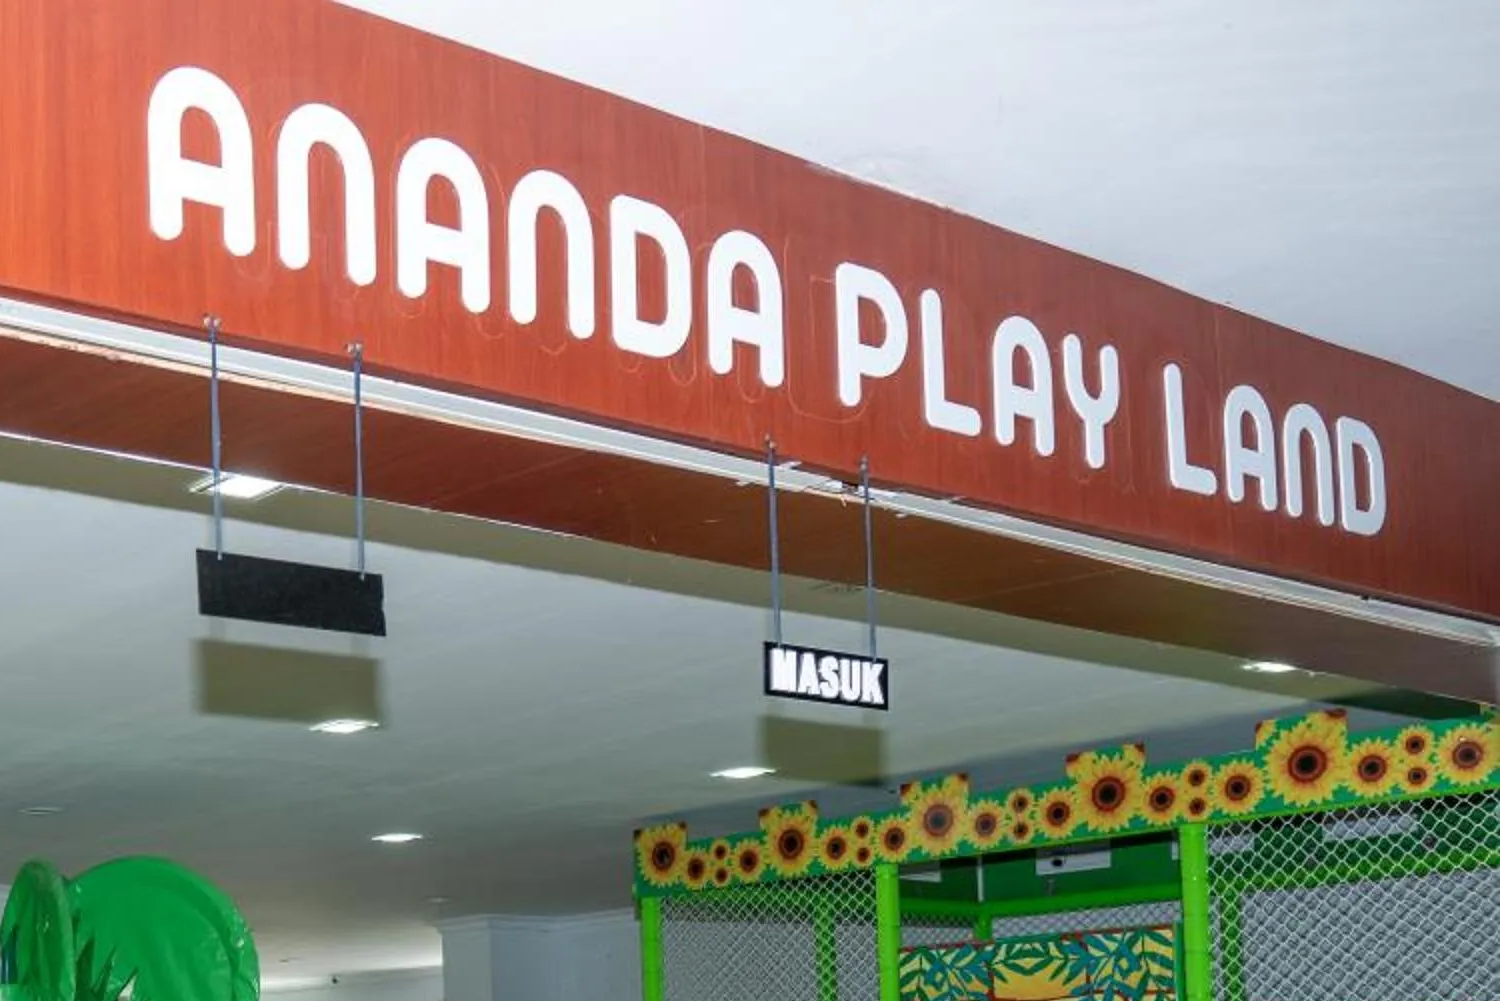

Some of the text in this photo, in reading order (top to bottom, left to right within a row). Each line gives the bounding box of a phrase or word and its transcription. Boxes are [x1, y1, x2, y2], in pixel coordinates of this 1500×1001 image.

[145, 64, 1387, 535] ANANDA PLAY LAND
[769, 647, 885, 705] MASUK
